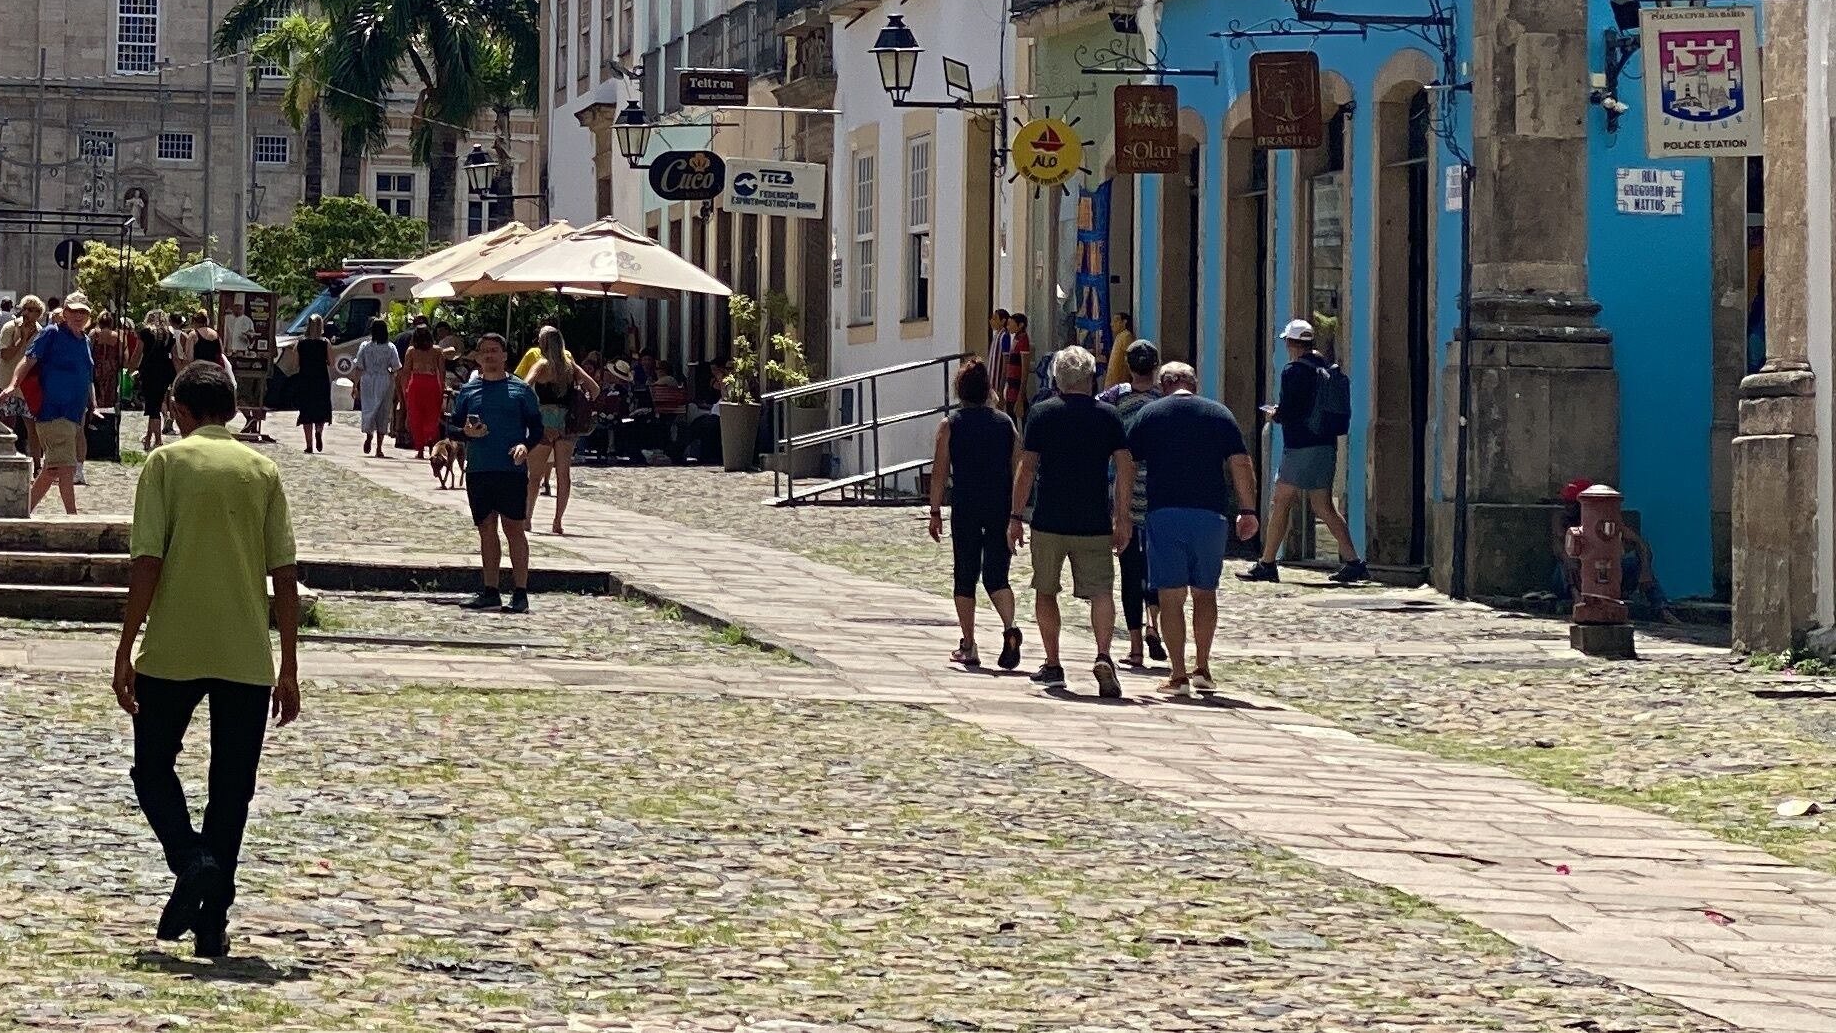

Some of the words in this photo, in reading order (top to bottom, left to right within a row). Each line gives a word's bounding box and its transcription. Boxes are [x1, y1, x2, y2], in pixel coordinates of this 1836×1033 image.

[689, 77, 734, 89] Teltron
[1663, 140, 1701, 150] POLICE
[1703, 139, 1748, 149] STATION
[661, 159, 714, 192] Cuco
[1642, 170, 1658, 183] RUA
[1665, 185, 1676, 198] DE
